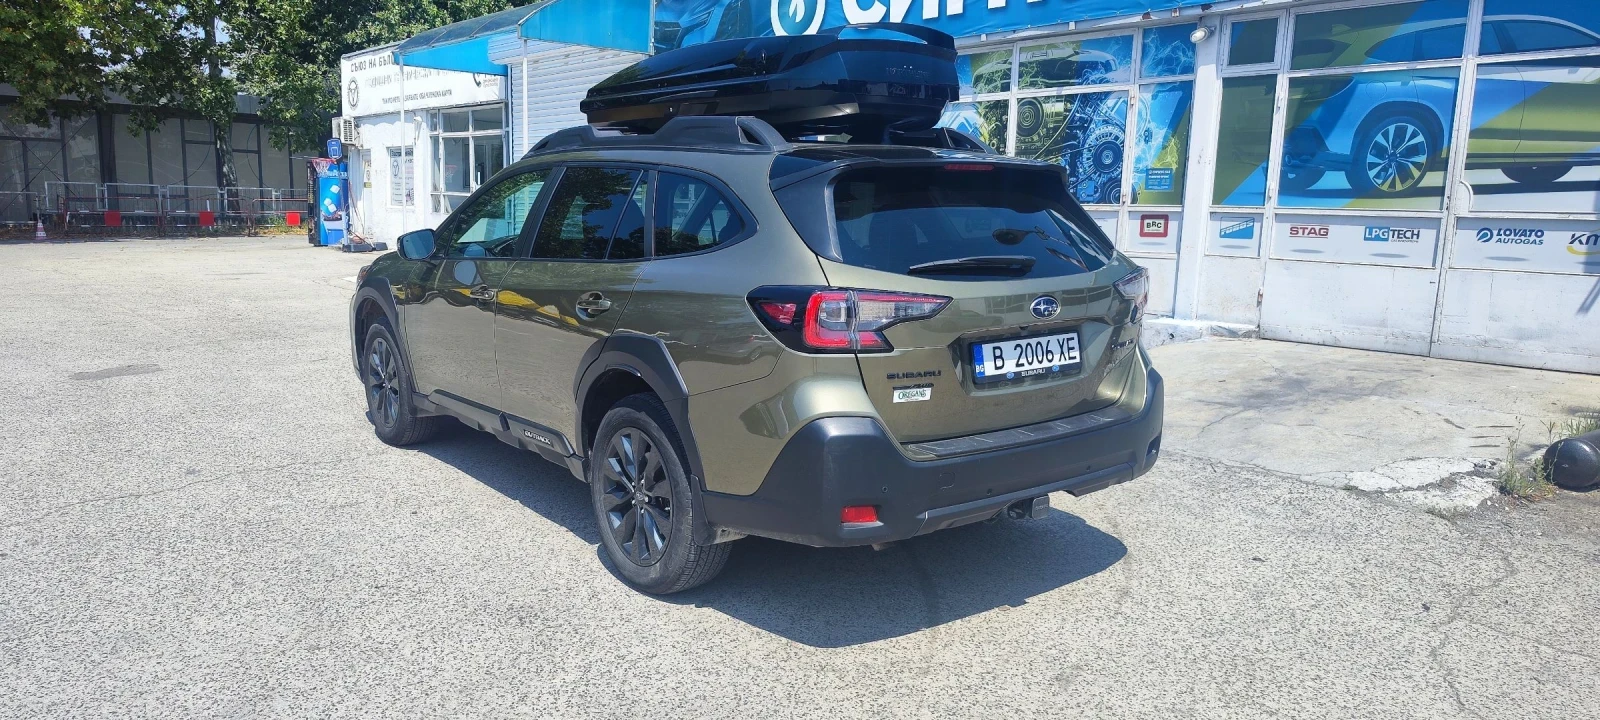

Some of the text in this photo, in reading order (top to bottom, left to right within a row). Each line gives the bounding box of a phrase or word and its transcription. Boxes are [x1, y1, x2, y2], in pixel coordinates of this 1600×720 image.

[351, 60, 366, 72] СЪЮЗ
[369, 58, 376, 68] НА
[1146, 221, 1162, 229] BRC
[1289, 226, 1329, 237] STAG
[1496, 228, 1545, 239] LOVATO
[1495, 237, 1544, 246] AUTOGAS
[992, 337, 1077, 371] B 2006 XE
[975, 364, 984, 373] BG
[1021, 368, 1046, 377] SUBARU
[886, 370, 942, 380] SUBARU
